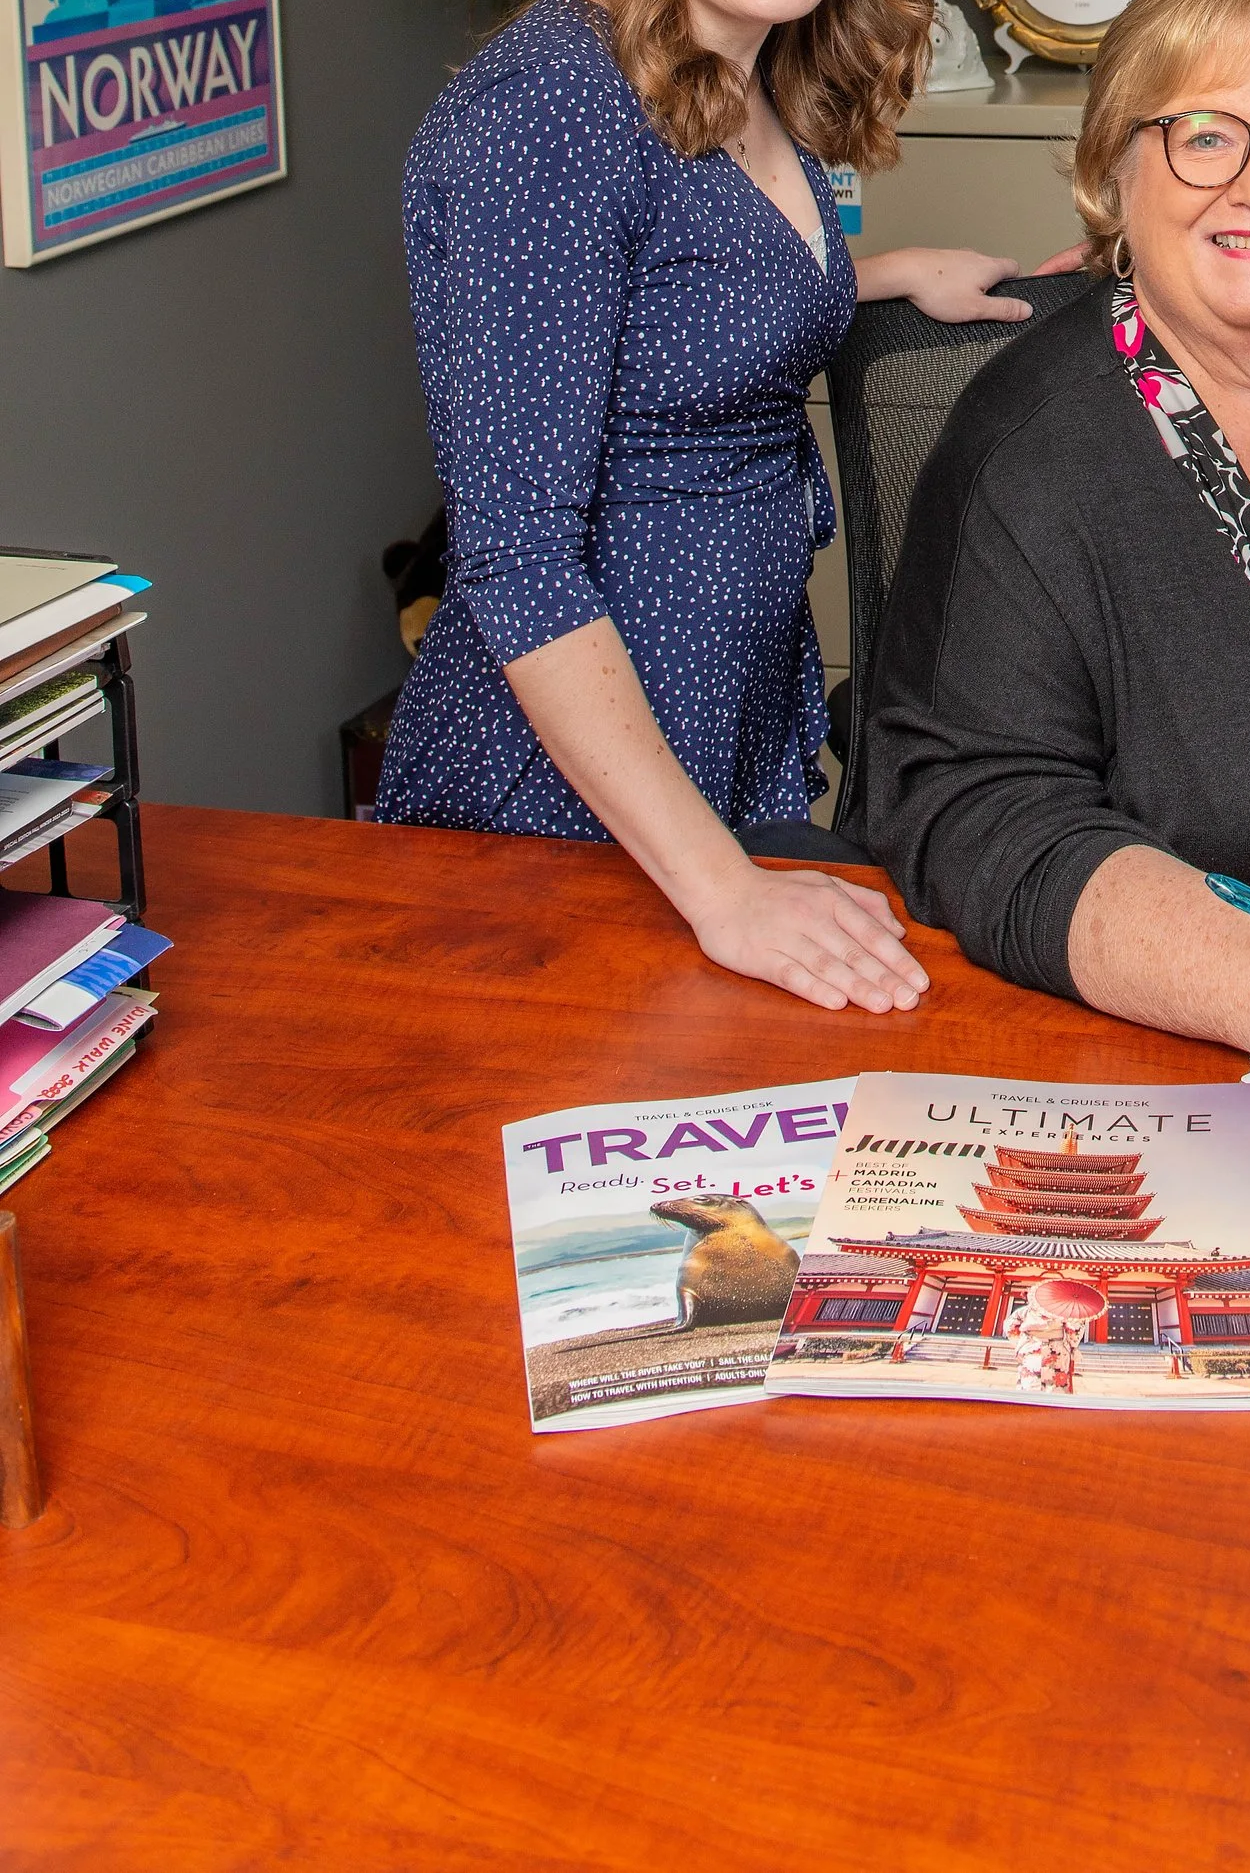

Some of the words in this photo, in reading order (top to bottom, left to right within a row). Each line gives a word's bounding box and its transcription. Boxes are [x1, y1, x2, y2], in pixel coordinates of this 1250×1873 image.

[40, 19, 258, 148] NORWAY
[47, 162, 142, 207] NORWEGIAN
[147, 142, 225, 176] CARIBBEAN
[228, 124, 266, 150] LINES
[111, 1006, 149, 1036] WINE
[72, 1037, 115, 1072] WALK
[635, 1113, 681, 1122] TRAVEL
[695, 1106, 739, 1116] CRUISE
[743, 1100, 773, 1111] DESK
[991, 1093, 1040, 1104] TRAVEL
[1047, 1097, 1055, 1105] &
[1060, 1098, 1110, 1107] CRUISE
[1115, 1100, 1150, 1108] DESK
[927, 1103, 1212, 1133] ULTIMATE
[845, 1134, 987, 1158] Japan
[982, 1127, 1150, 1143] EXPERIENCES
[561, 1174, 645, 1195] Ready.
[650, 1174, 716, 1194] Set.
[732, 1174, 816, 1198] Let's
[851, 1179, 937, 1189] CANADIAN
[845, 1197, 945, 1207] ADRENALINE
[569, 1377, 599, 1389] WHERE
[600, 1373, 620, 1383] WILL
[620, 1370, 637, 1378] THE
[638, 1365, 663, 1377] RIVER
[664, 1363, 684, 1372] TAKE
[685, 1360, 706, 1370] YOU?
[719, 1357, 737, 1366] SAIL
[738, 1355, 754, 1364] THE
[571, 1392, 591, 1403] HOW
[592, 1389, 603, 1398] TO
[604, 1385, 636, 1397] TRAVEL
[636, 1380, 658, 1392] WITH
[659, 1375, 702, 1388] INTENTION
